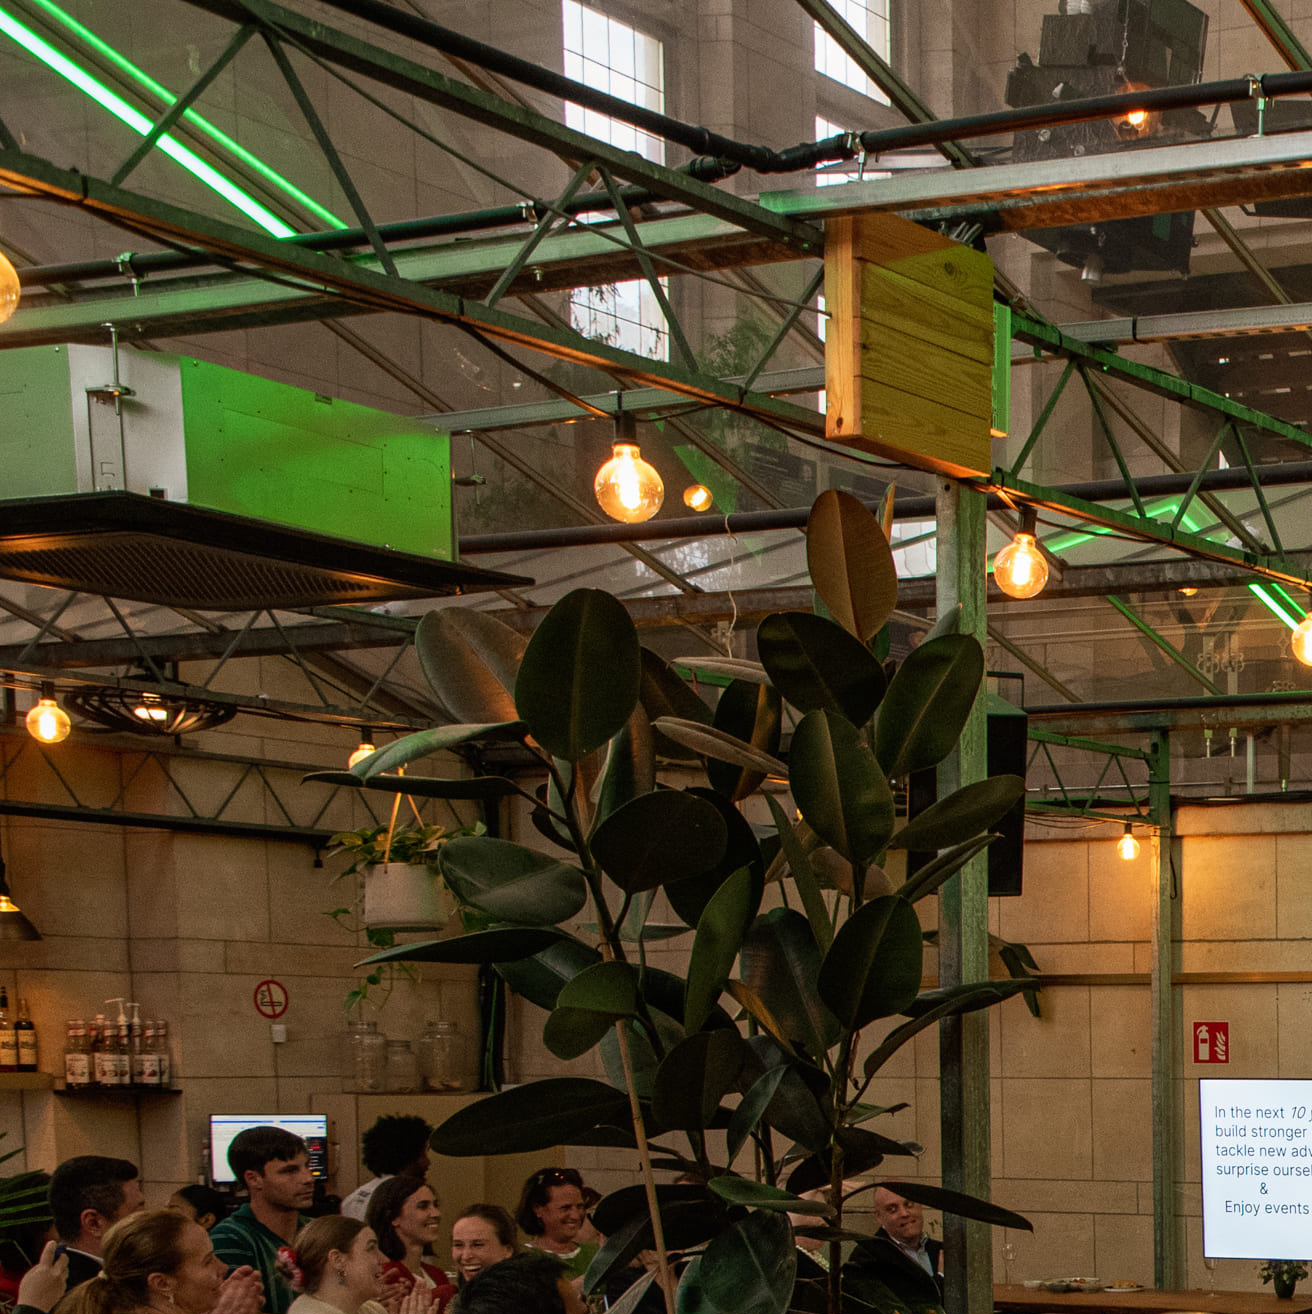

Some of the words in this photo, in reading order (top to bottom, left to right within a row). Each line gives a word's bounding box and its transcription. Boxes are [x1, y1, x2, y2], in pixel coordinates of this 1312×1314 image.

[1214, 1106, 1226, 1118] In
[1230, 1107, 1252, 1118] the
[1255, 1107, 1285, 1118] next
[1291, 1106, 1307, 1119] 10
[1215, 1125, 1247, 1137] build
[1251, 1126, 1308, 1141] stronger
[1215, 1144, 1255, 1156] tackle
[1259, 1147, 1287, 1157] new
[1216, 1163, 1270, 1178] surprise
[1259, 1182, 1269, 1194] &
[1224, 1200, 1261, 1216] Enjoy
[1264, 1203, 1310, 1214] events
